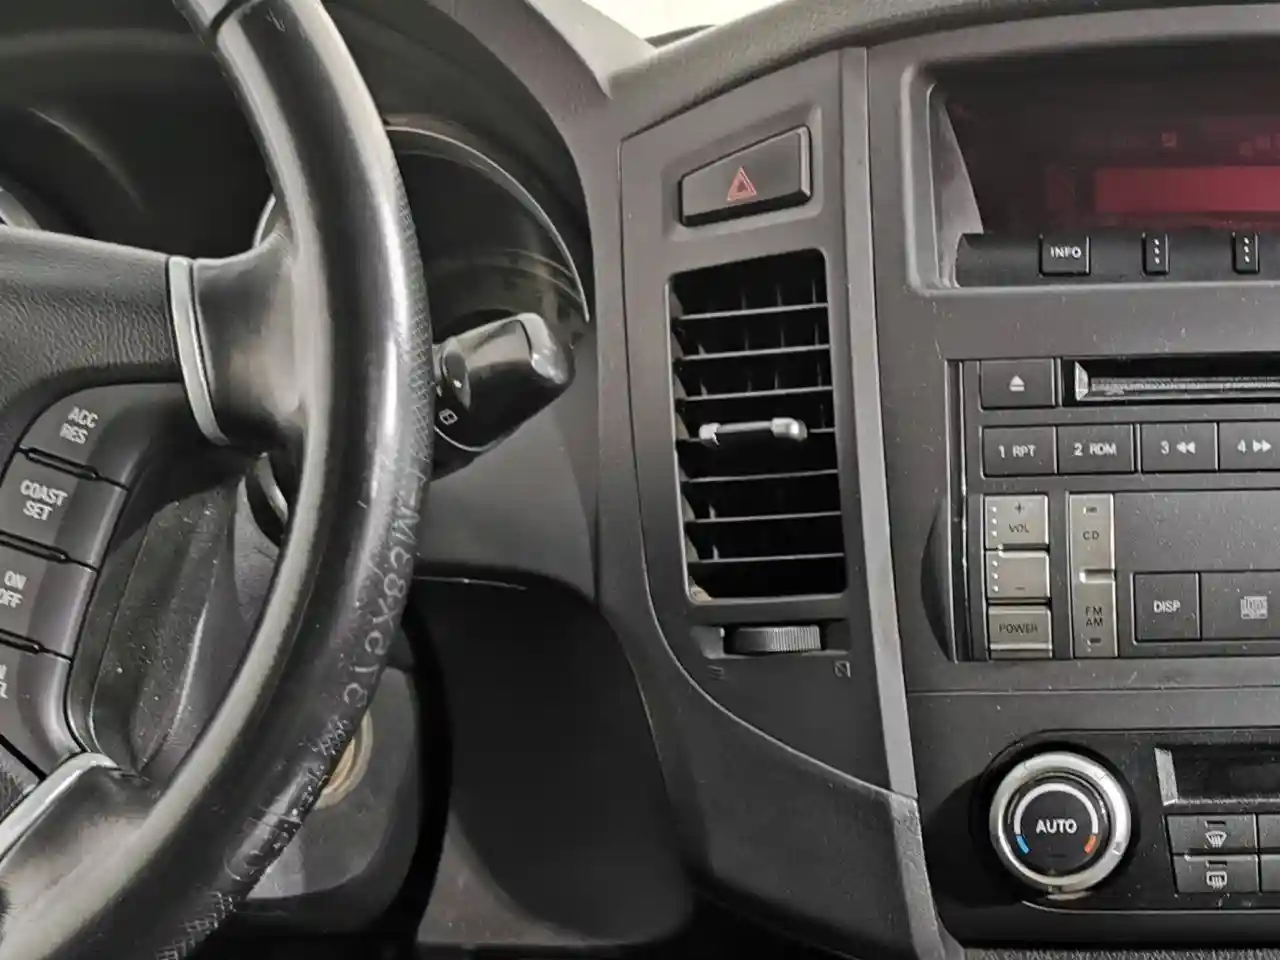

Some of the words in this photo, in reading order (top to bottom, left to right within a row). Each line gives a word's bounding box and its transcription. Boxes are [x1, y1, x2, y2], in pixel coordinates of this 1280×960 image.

[1050, 246, 1082, 258] INFO
[68, 406, 98, 428] ACC
[60, 423, 89, 444] RES
[998, 446, 1006, 458] 1
[1013, 445, 1036, 458] RPT
[1074, 442, 1083, 456] 2
[1090, 442, 1117, 456] RDM
[1161, 441, 1169, 454] 3
[1237, 439, 1247, 453] 4
[20, 480, 68, 506] COAST
[23, 500, 53, 520] SET
[1008, 523, 1030, 533] VOL
[1083, 530, 1100, 541] CD
[4, 570, 27, 590] ON
[1085, 606, 1103, 616] FM
[1153, 600, 1181, 613] DISP
[999, 623, 1038, 634] POWER
[1086, 617, 1103, 627] AM
[1035, 818, 1078, 834] AUTO
